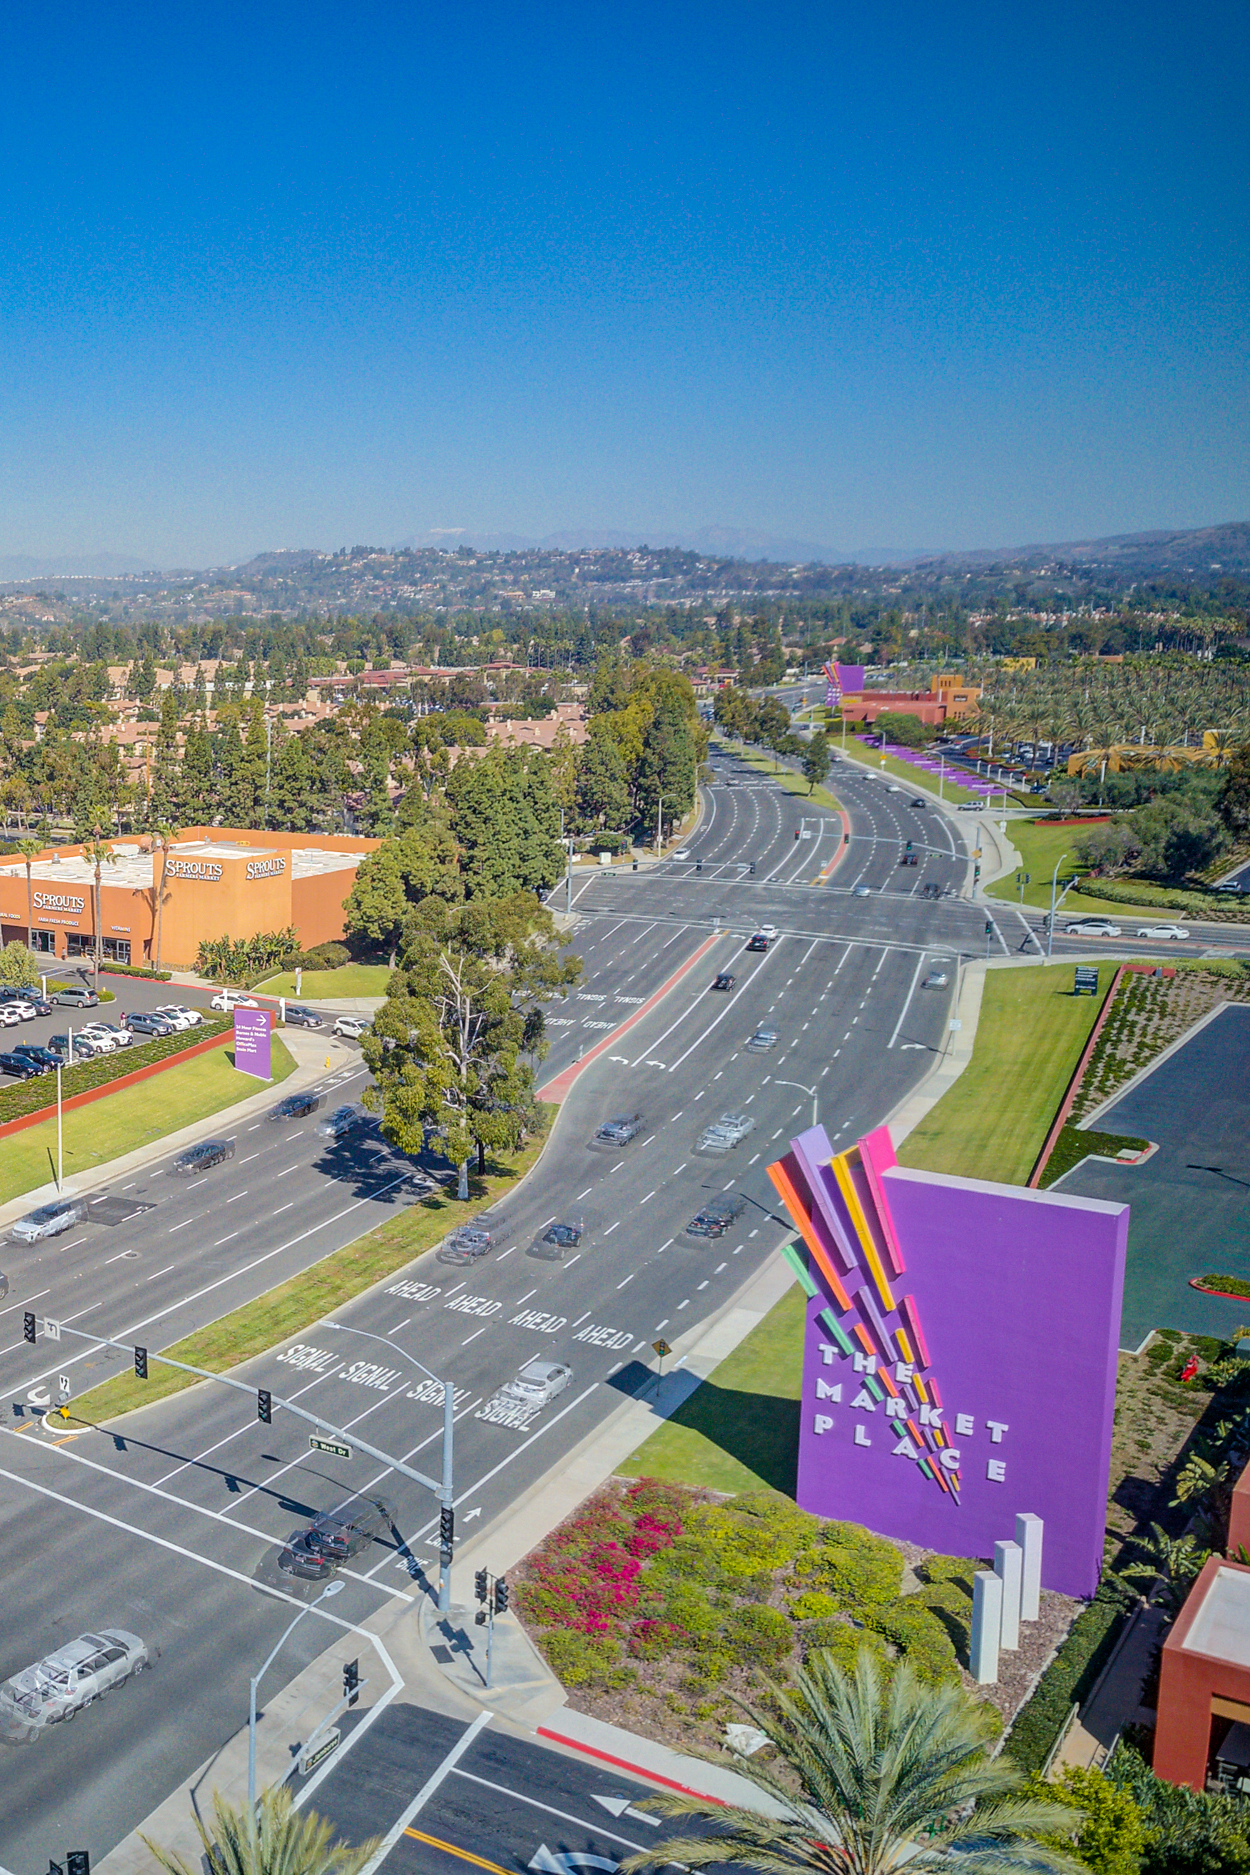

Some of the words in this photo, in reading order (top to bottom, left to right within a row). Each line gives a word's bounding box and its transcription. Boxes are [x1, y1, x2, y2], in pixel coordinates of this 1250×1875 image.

[165, 859, 223, 877] SPROUTS
[176, 872, 198, 880] FARMERS
[199, 874, 220, 882] MARKET
[246, 857, 287, 881] SPROUTS
[33, 892, 85, 909] SPROUTS
[63, 906, 83, 914] MARKET
[576, 993, 607, 1001] SIGNAL
[614, 996, 646, 1004] SIGNAL
[583, 1021, 617, 1029] AHEAD
[384, 1279, 442, 1301] AHEAD
[443, 1294, 502, 1317] AHEAD
[507, 1309, 568, 1333] AHEAD
[572, 1324, 634, 1350] AHEAD
[276, 1344, 339, 1373] SIGNAL
[818, 1343, 915, 1383] THE
[338, 1361, 402, 1391] SIGNAL
[815, 1378, 1010, 1443] MARKET
[813, 1414, 1007, 1482] PLACE
